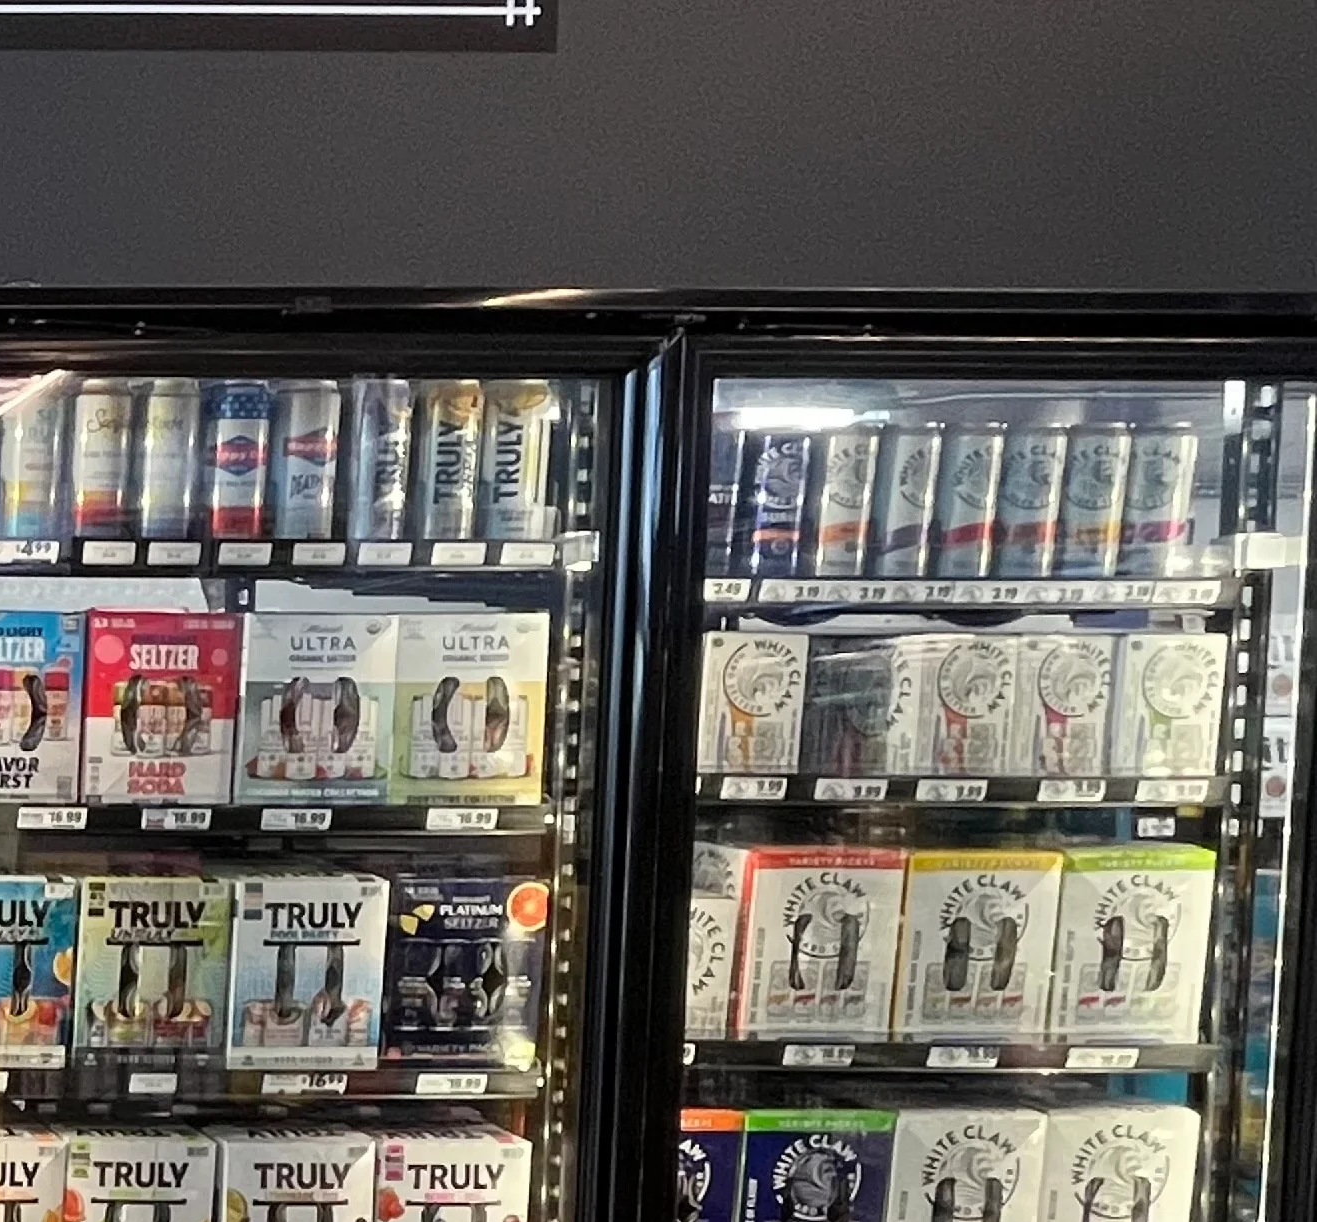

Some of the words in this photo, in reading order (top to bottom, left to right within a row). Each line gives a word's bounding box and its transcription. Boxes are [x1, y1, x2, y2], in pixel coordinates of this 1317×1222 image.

[435, 421, 461, 503] TRULY
[494, 421, 520, 503] TRULY
[129, 644, 199, 670] SELTZER
[290, 637, 357, 652] ULTRA
[442, 637, 510, 651] ULTRA
[755, 640, 799, 666] WHITE
[128, 762, 184, 779] HARD
[128, 779, 185, 796] SODA
[440, 905, 504, 916] PLATINUM
[783, 880, 815, 929] WHITE
[820, 873, 867, 898] CLAW
[939, 881, 972, 930] WHITE
[975, 876, 1023, 902] CLAW
[1094, 881, 1127, 930] WHITE
[1130, 875, 1176, 902] CLAW
[108, 901, 206, 928] TRULY
[265, 902, 363, 929] TRULY
[443, 917, 499, 929] SELTZER
[270, 930, 299, 940] POOL
[303, 930, 339, 940] PARTY
[773, 1141, 806, 1190] WHITE
[810, 1134, 856, 1163] CLAW
[922, 1130, 959, 1186] WHITE
[963, 1125, 1016, 1154] CLAW
[1072, 1129, 1110, 1185] WHITE
[1113, 1124, 1165, 1154] CLAW
[93, 1162, 190, 1188] TRULY
[255, 1163, 351, 1189] TRULY
[407, 1164, 504, 1190] TRULY
